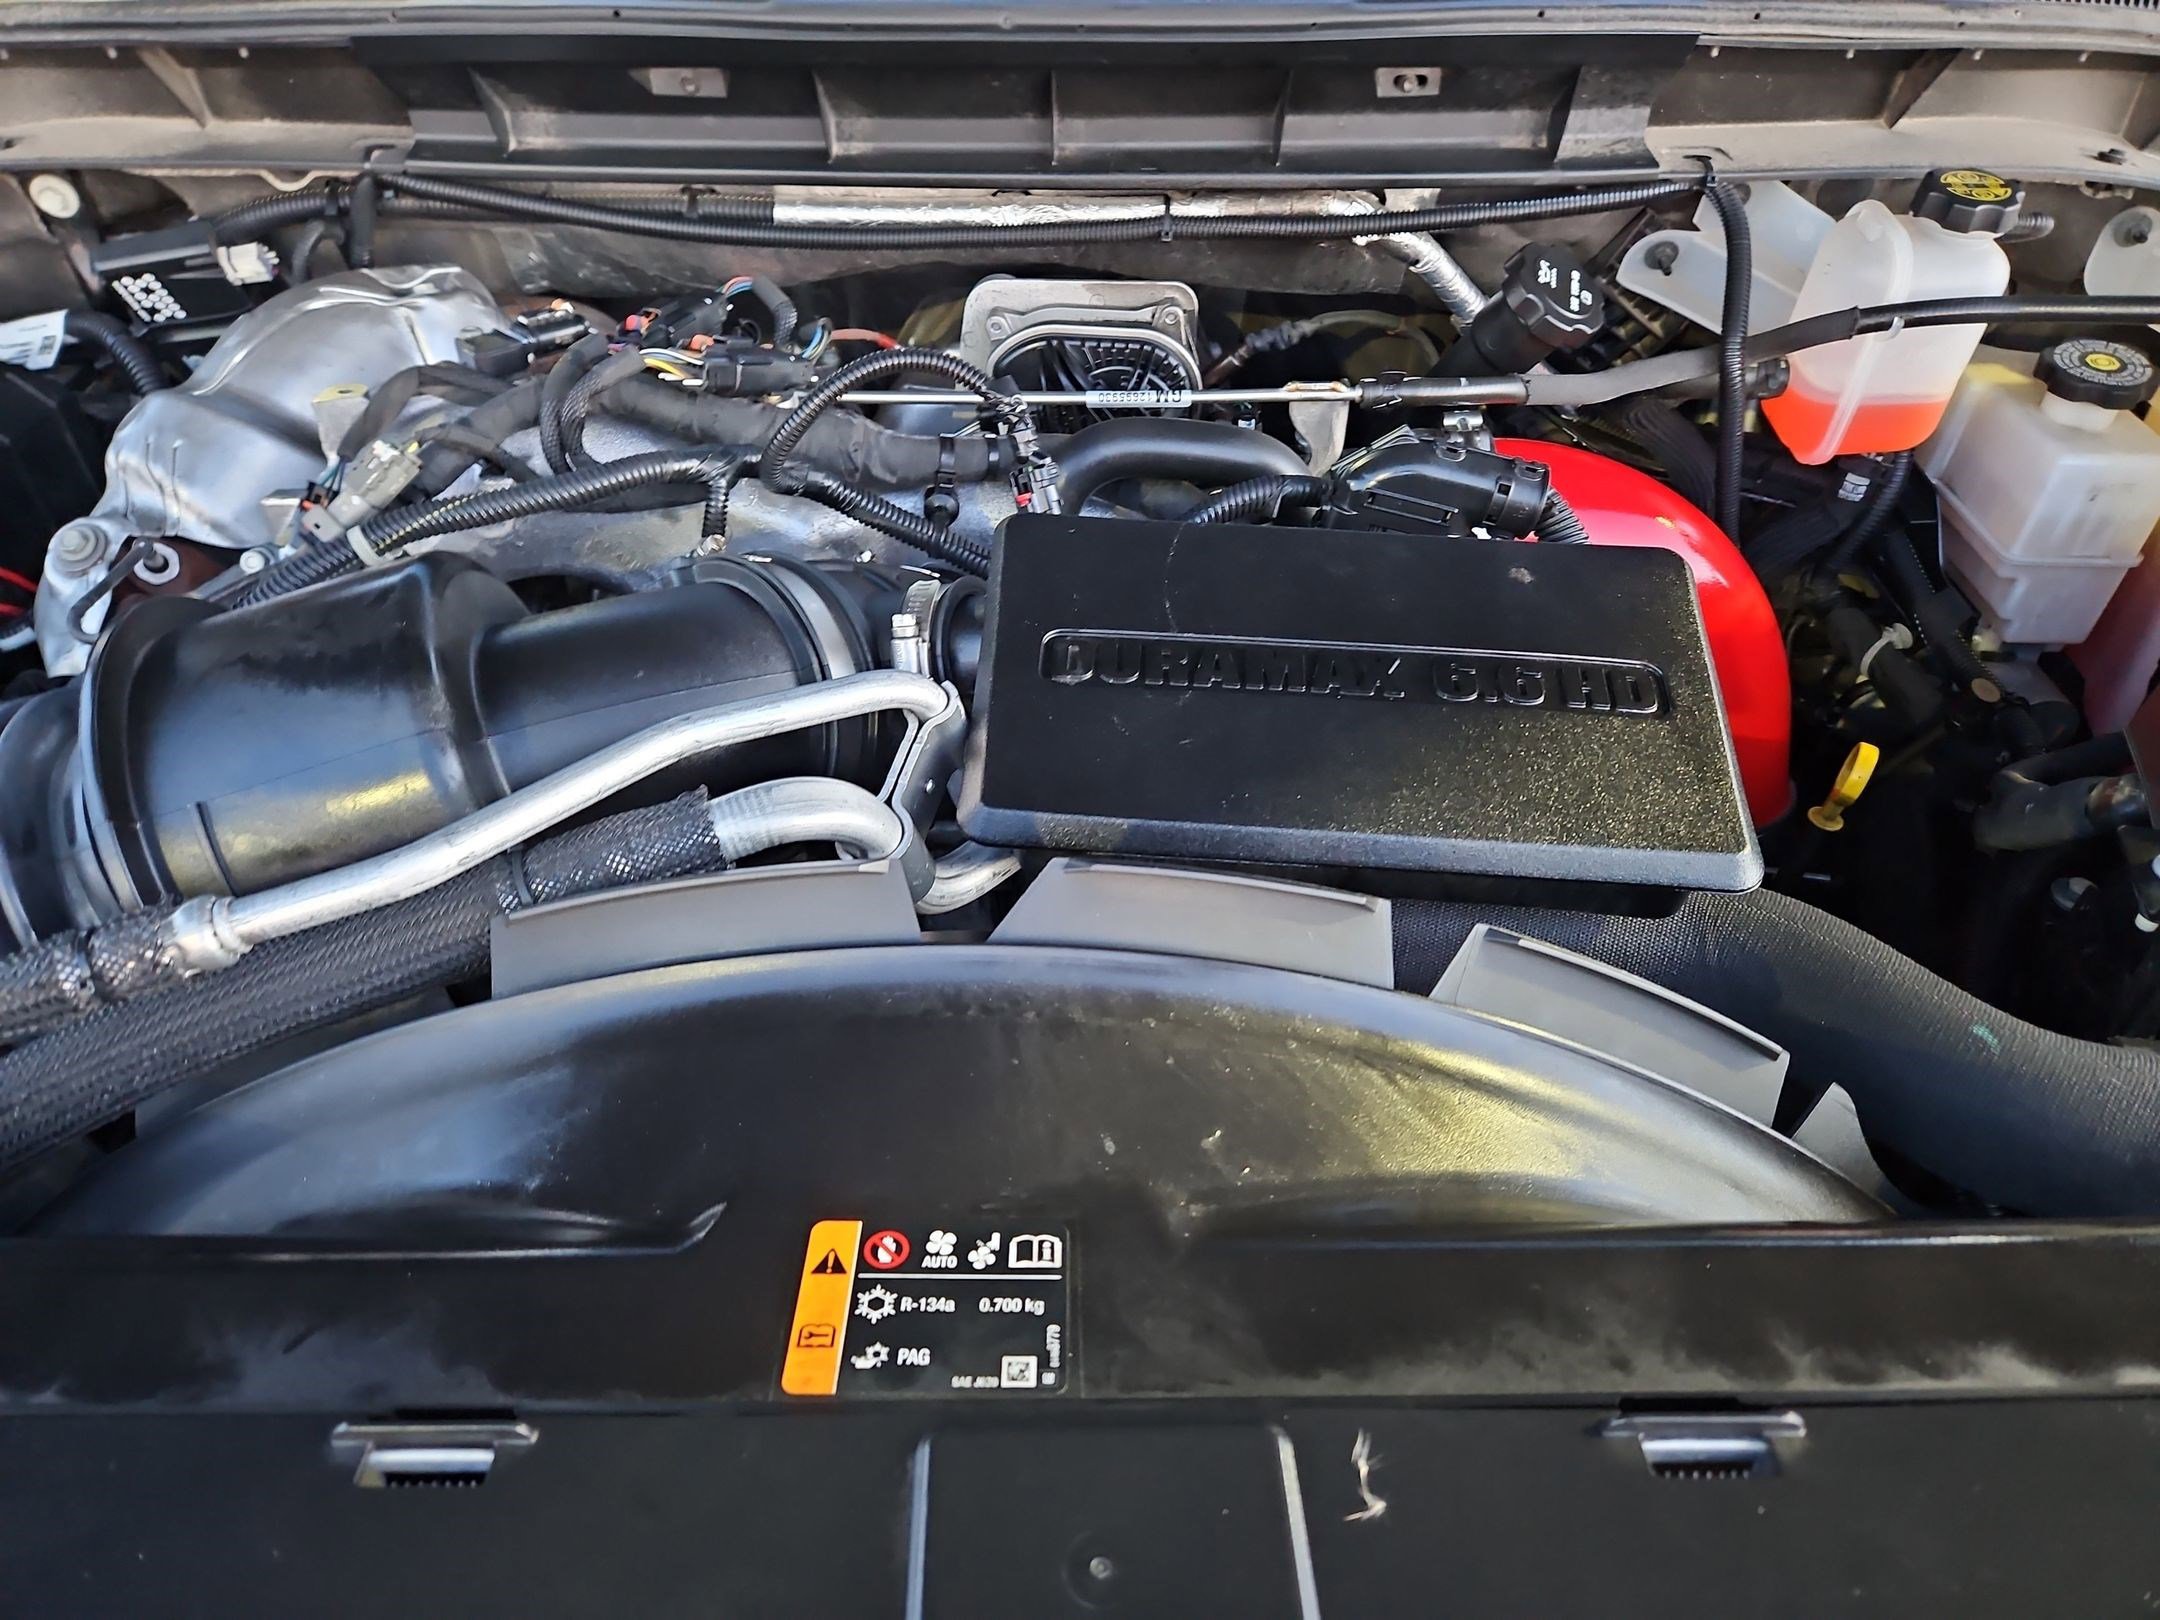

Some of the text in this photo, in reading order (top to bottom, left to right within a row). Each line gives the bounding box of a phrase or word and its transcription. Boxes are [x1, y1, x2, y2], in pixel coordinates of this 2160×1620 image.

[1155, 390, 1182, 403] GM
[1049, 638, 1660, 714] DURAMAX 6.6 HD
[922, 1255, 957, 1268] AUTO
[900, 1297, 1045, 1316] R-134a 0.700 kg
[897, 1348, 931, 1366] PAG
